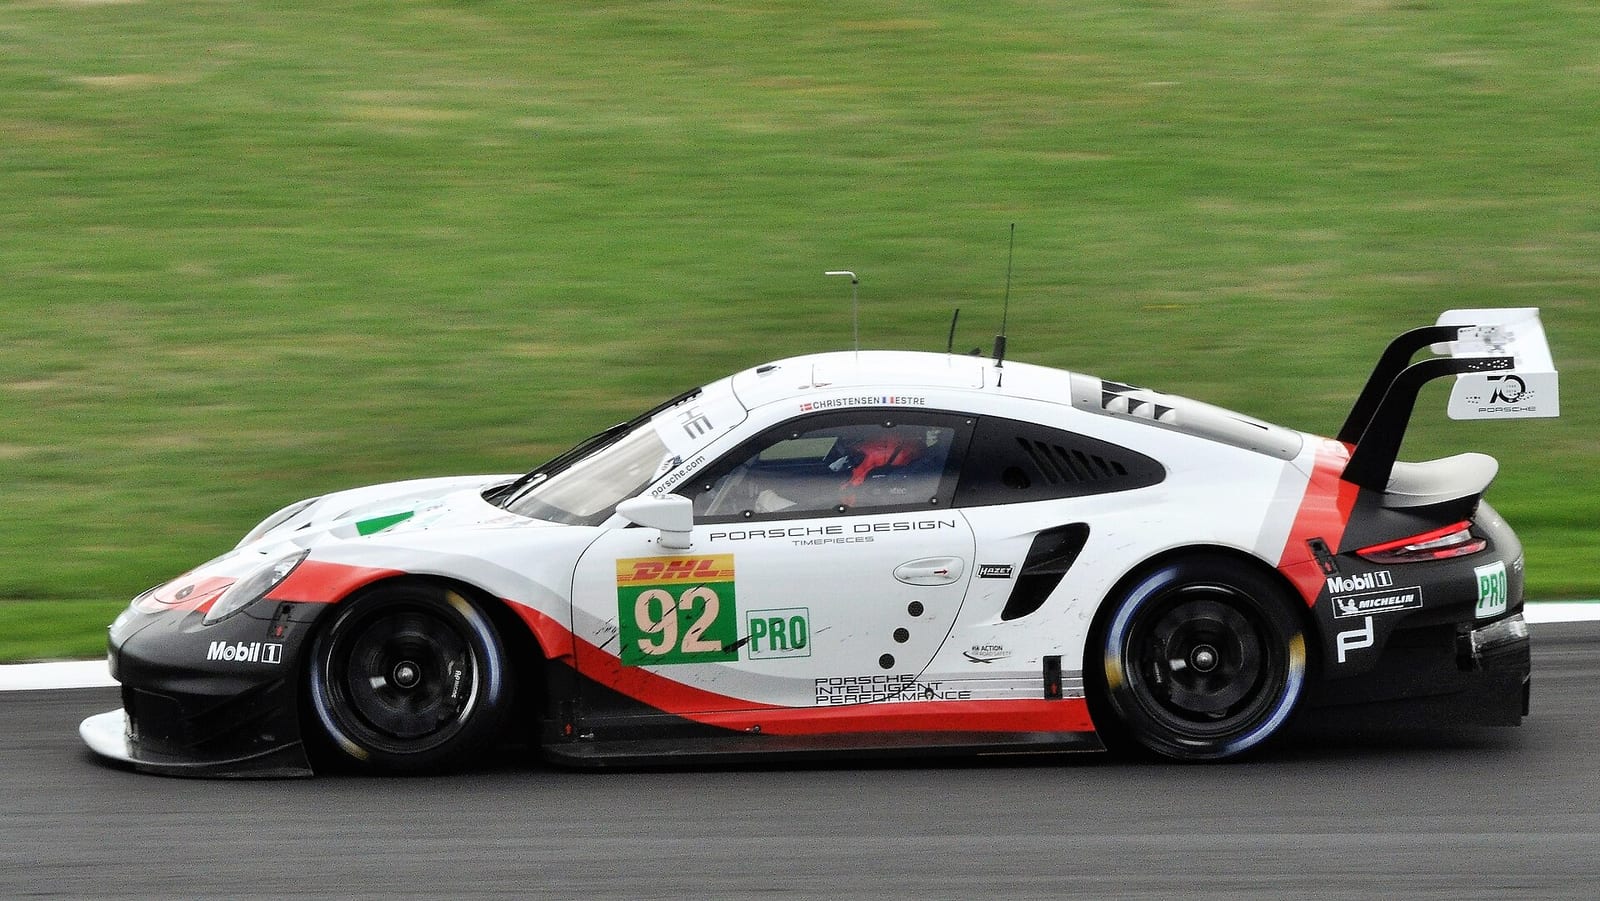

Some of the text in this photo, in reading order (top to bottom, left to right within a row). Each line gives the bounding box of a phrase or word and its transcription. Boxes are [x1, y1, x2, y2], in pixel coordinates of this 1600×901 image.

[812, 396, 925, 409] CHRISTENSEN ESTRE
[651, 455, 706, 498] porsche.com
[710, 520, 955, 541] PORSCHE DESIGN
[792, 536, 874, 546] TIMEPIECES
[632, 560, 720, 580] DHL
[980, 567, 1011, 575] HAZET
[1327, 572, 1375, 594] Mobil
[1479, 571, 1505, 609] PRO
[1358, 594, 1414, 609] MICHELIN
[635, 586, 722, 655] 92
[750, 615, 807, 652] PRO
[207, 641, 260, 662] Mobil
[815, 674, 914, 686] PORSCHE
[815, 682, 943, 694] INTELLIGENT
